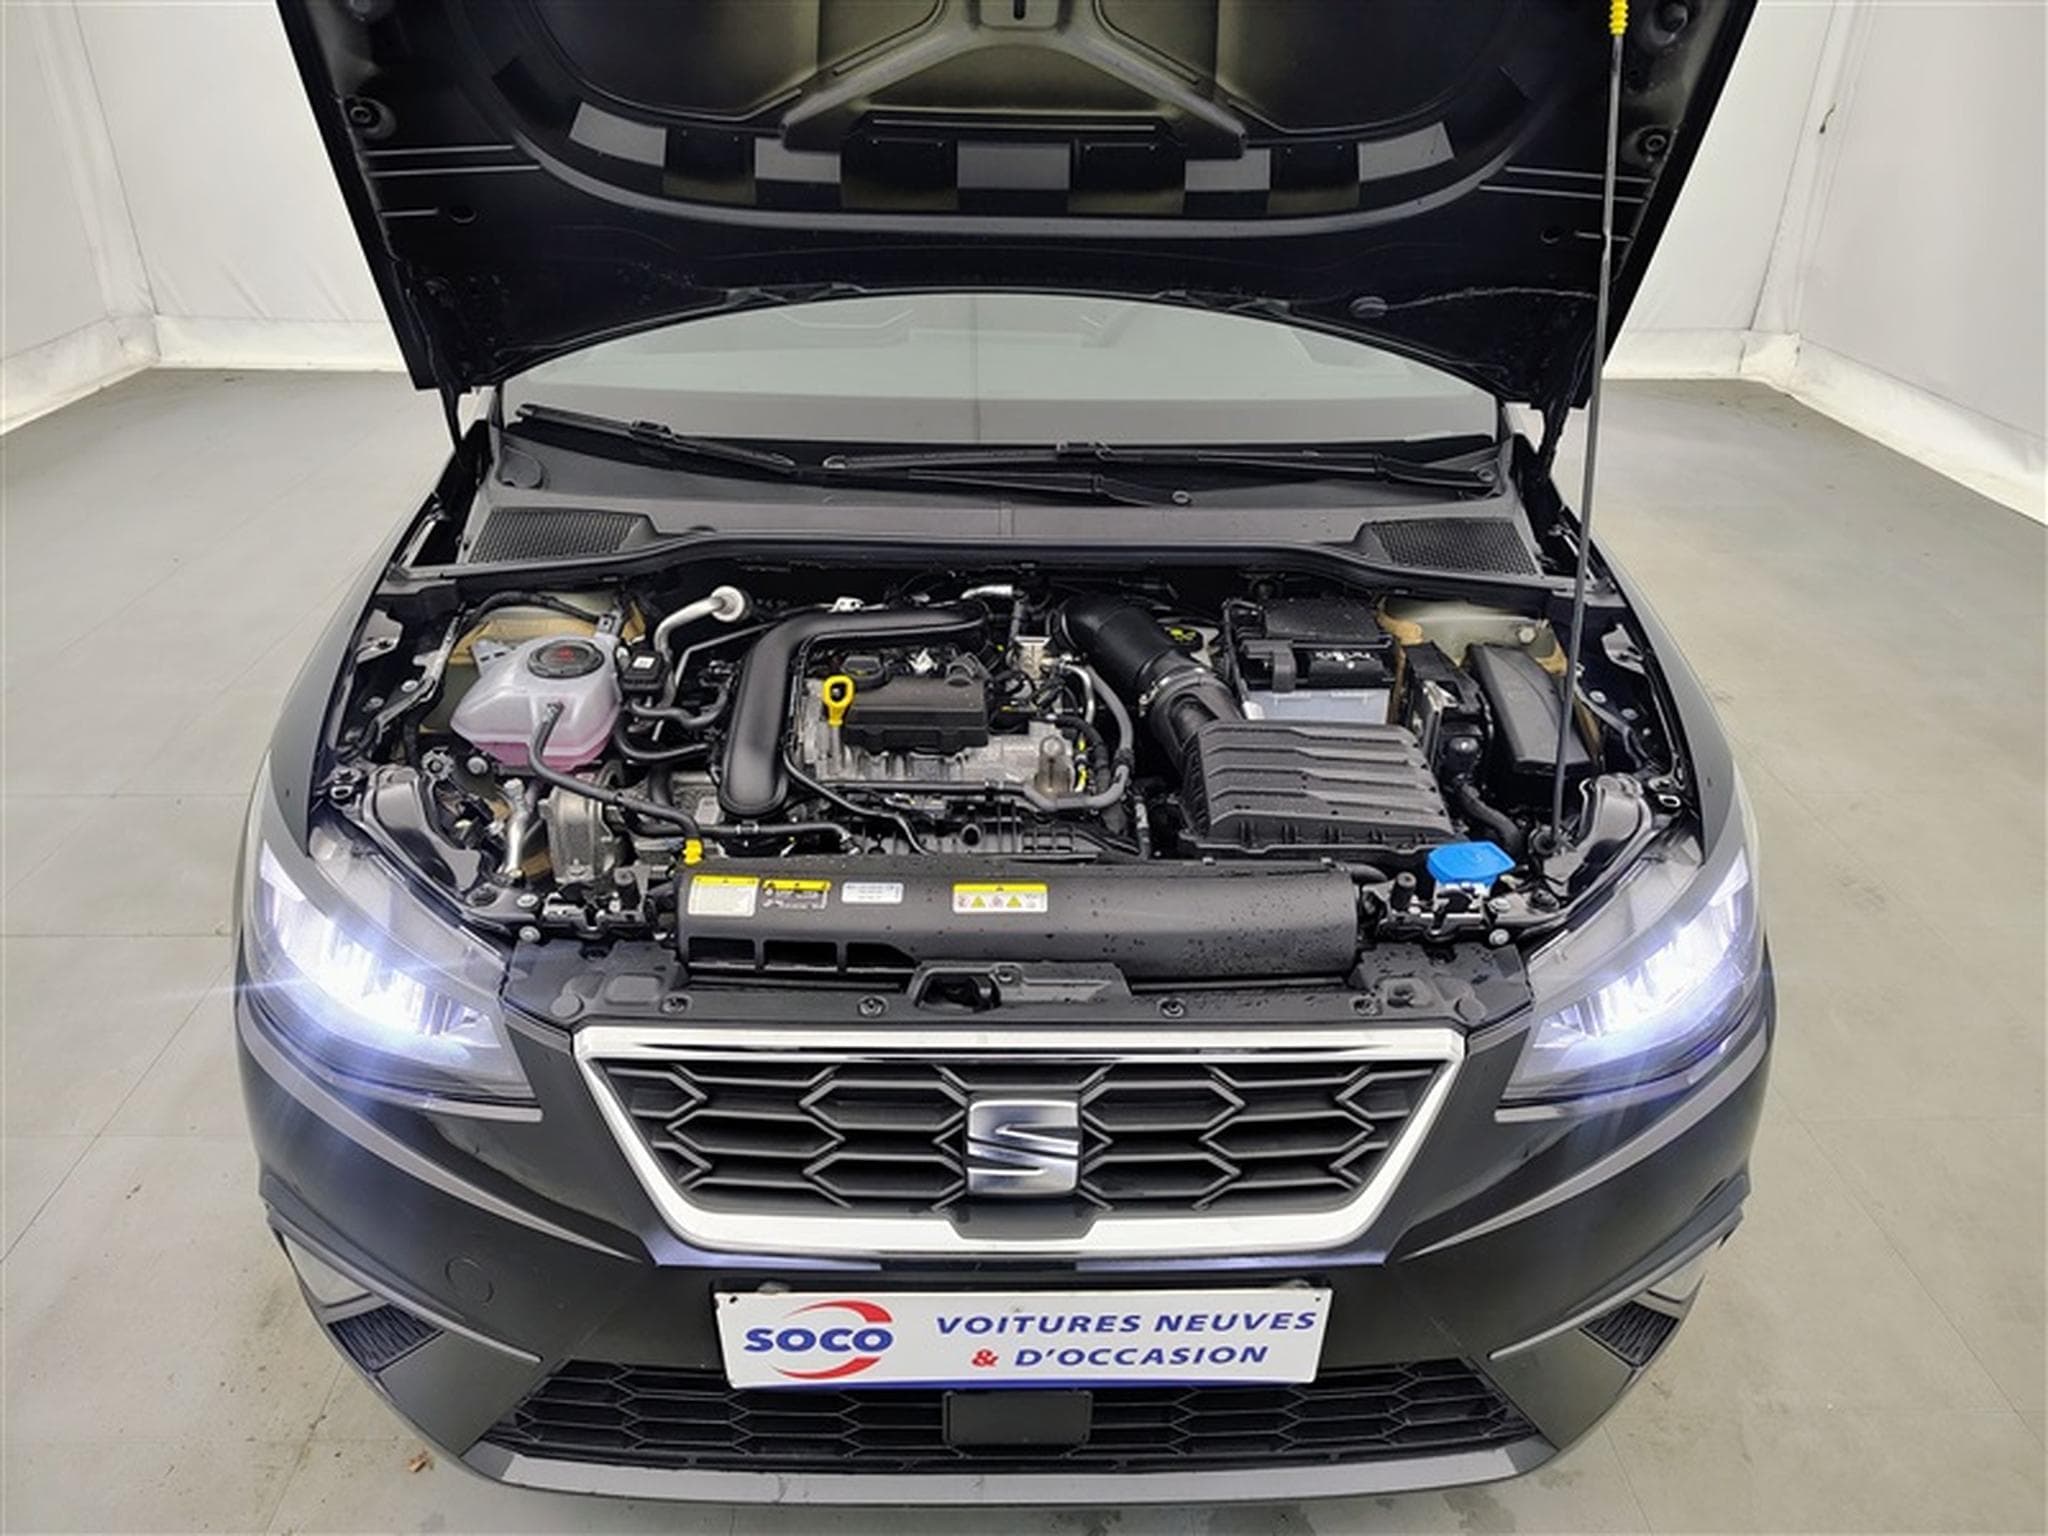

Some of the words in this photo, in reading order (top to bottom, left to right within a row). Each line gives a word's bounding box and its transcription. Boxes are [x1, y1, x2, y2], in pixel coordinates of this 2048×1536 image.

[936, 1313, 1142, 1335] VOITURES
[1155, 1311, 1318, 1333] NEUVES
[743, 1326, 895, 1354] SOCO
[971, 1349, 998, 1368] &
[1015, 1345, 1269, 1367] D'OCCASION
